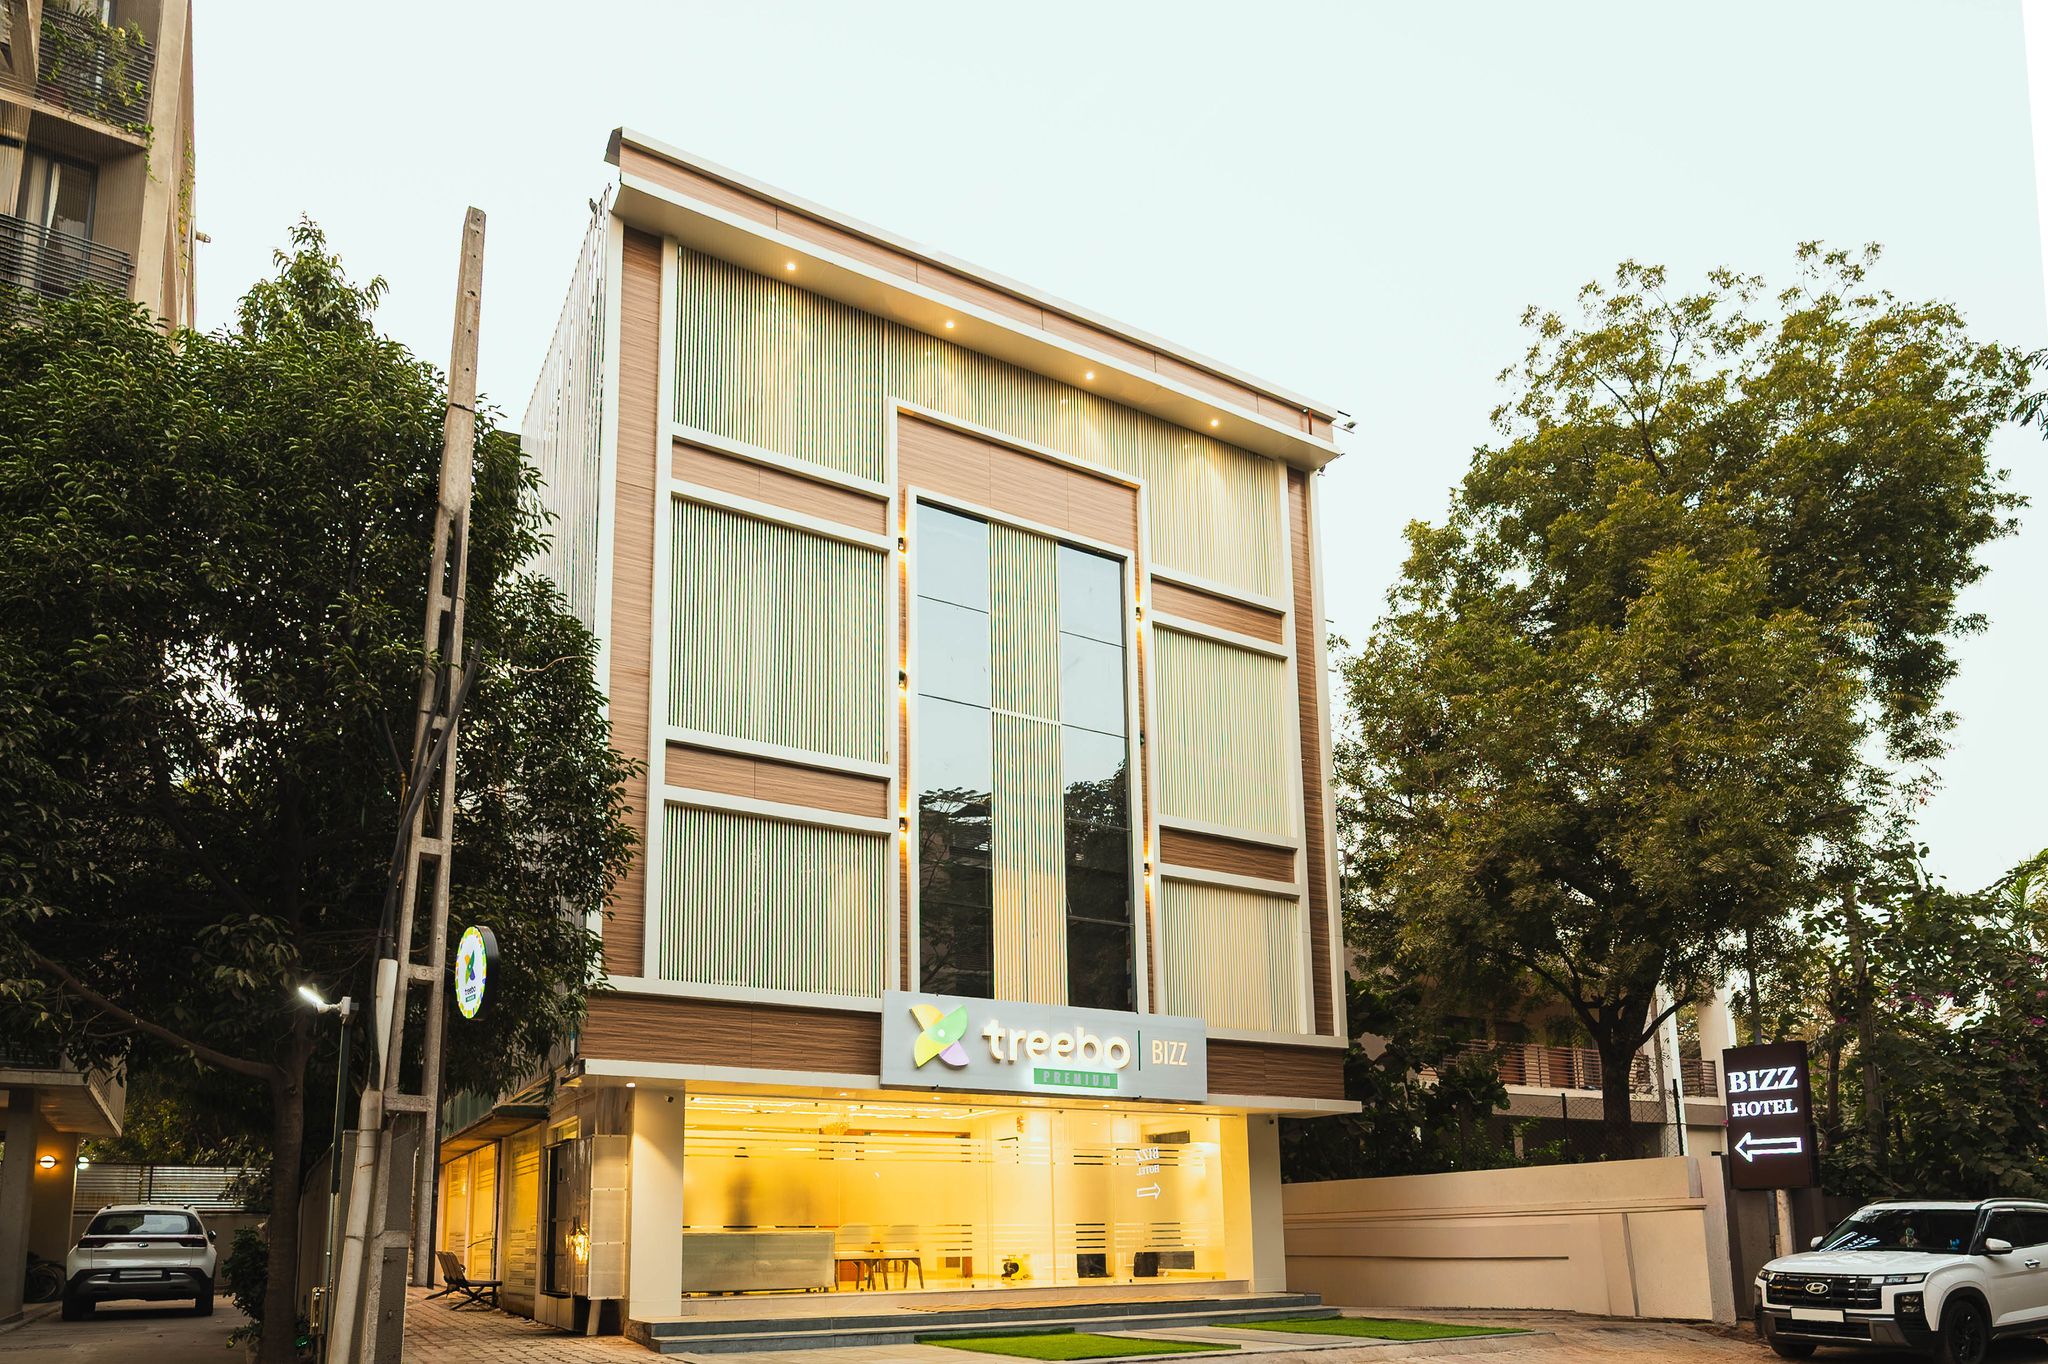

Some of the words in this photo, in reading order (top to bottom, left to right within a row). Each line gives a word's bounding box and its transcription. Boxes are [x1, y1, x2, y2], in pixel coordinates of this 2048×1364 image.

[982, 1019, 1131, 1069] treebo
[1152, 1039, 1188, 1066] BIZZ
[1043, 1071, 1111, 1086] PREMIUM
[1728, 1066, 1798, 1093] BIZZ
[1732, 1099, 1798, 1117] HOTEL
